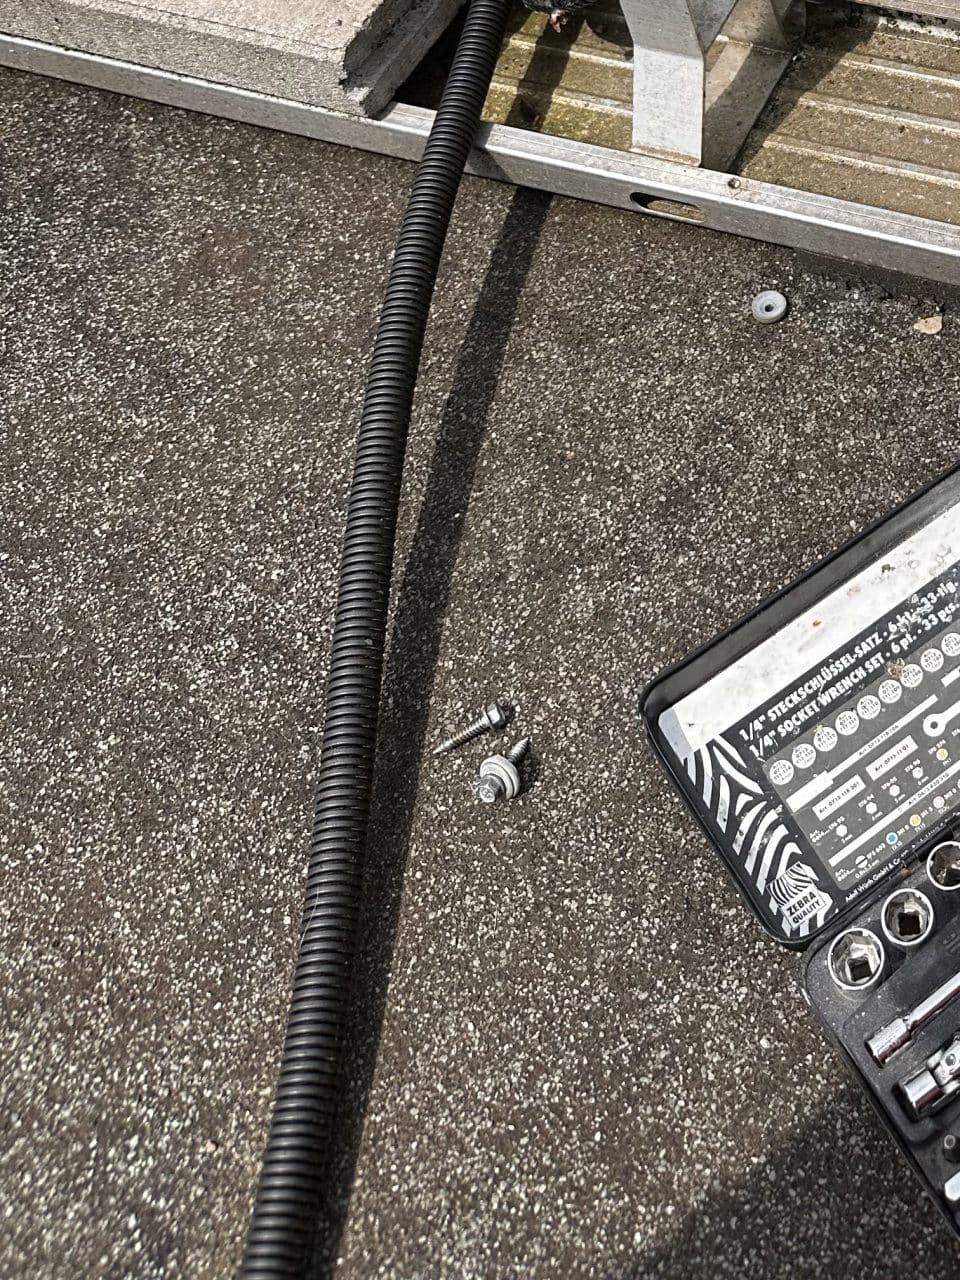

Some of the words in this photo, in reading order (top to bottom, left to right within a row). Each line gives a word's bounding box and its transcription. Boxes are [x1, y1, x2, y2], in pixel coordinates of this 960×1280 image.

[765, 631, 883, 721] STECKSCHLÜSSEL-SATZ
[775, 699, 820, 737] SOCKET
[816, 666, 867, 708] WRENCH
[864, 652, 886, 672] SET
[888, 640, 901, 654] 6
[919, 612, 940, 631] 33
[785, 890, 816, 915] ZEBRA
[791, 898, 822, 924] QUALITY
